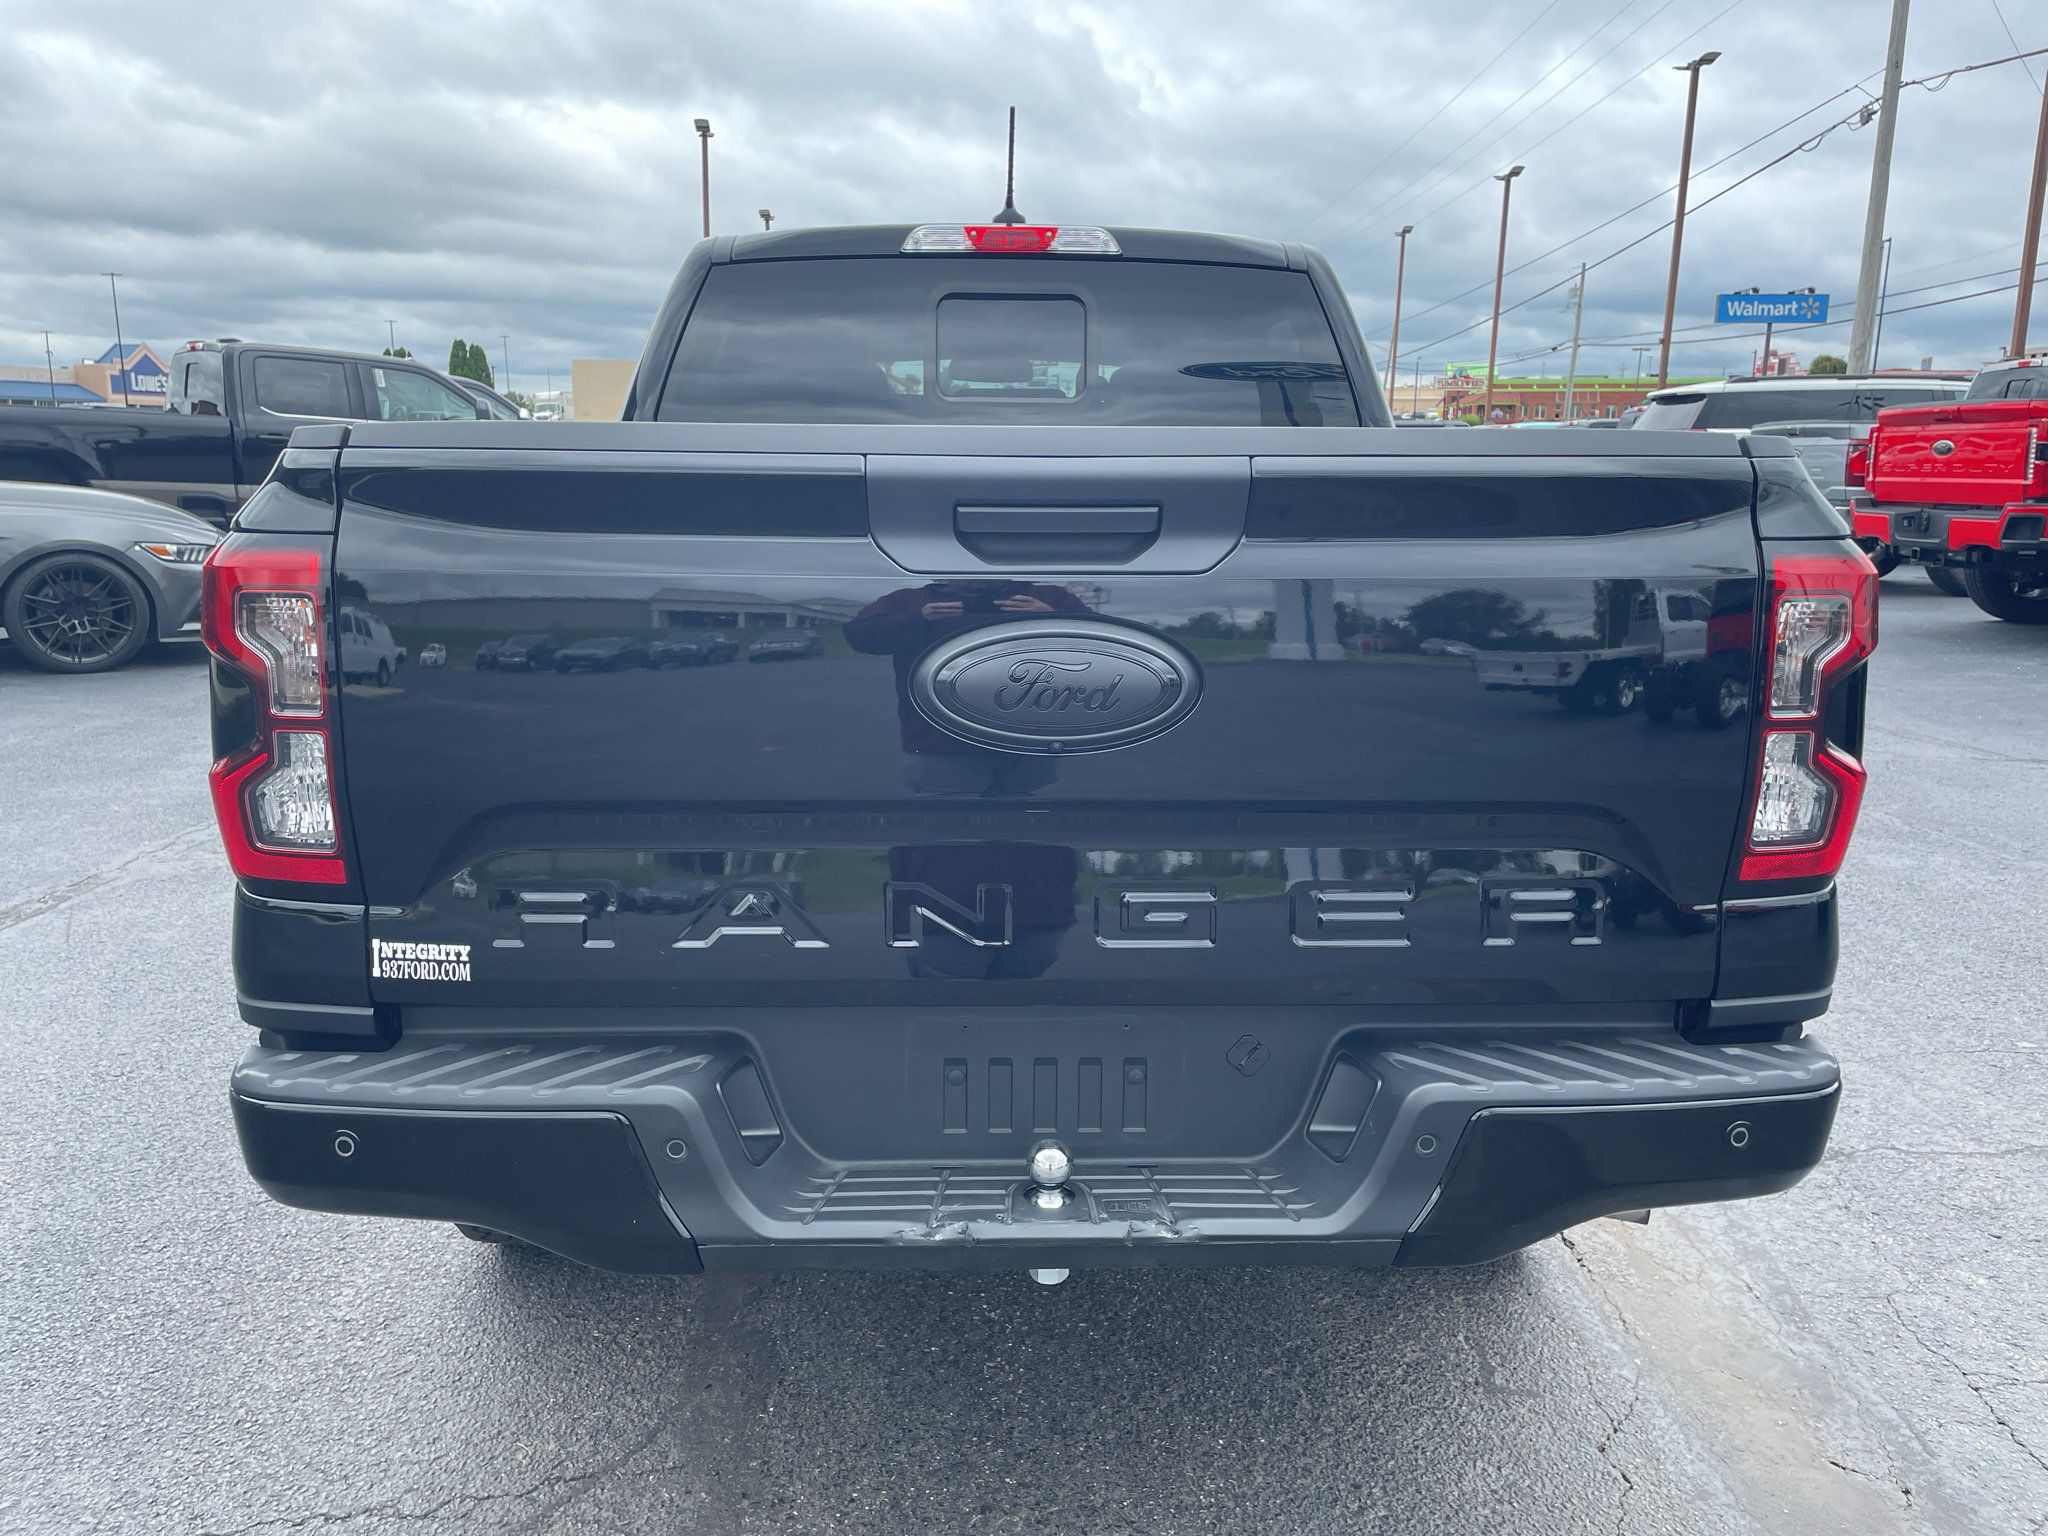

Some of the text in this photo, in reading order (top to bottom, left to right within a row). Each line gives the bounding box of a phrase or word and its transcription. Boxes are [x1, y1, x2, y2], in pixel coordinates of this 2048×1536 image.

[1727, 301, 1798, 316] Walmart
[1882, 463, 2015, 473] SUPER DUTY
[994, 658, 1124, 712] Ford
[491, 878, 1605, 950] RANGER
[372, 938, 471, 977] INTEGRITY
[382, 960, 471, 981] 937FORD.COM
